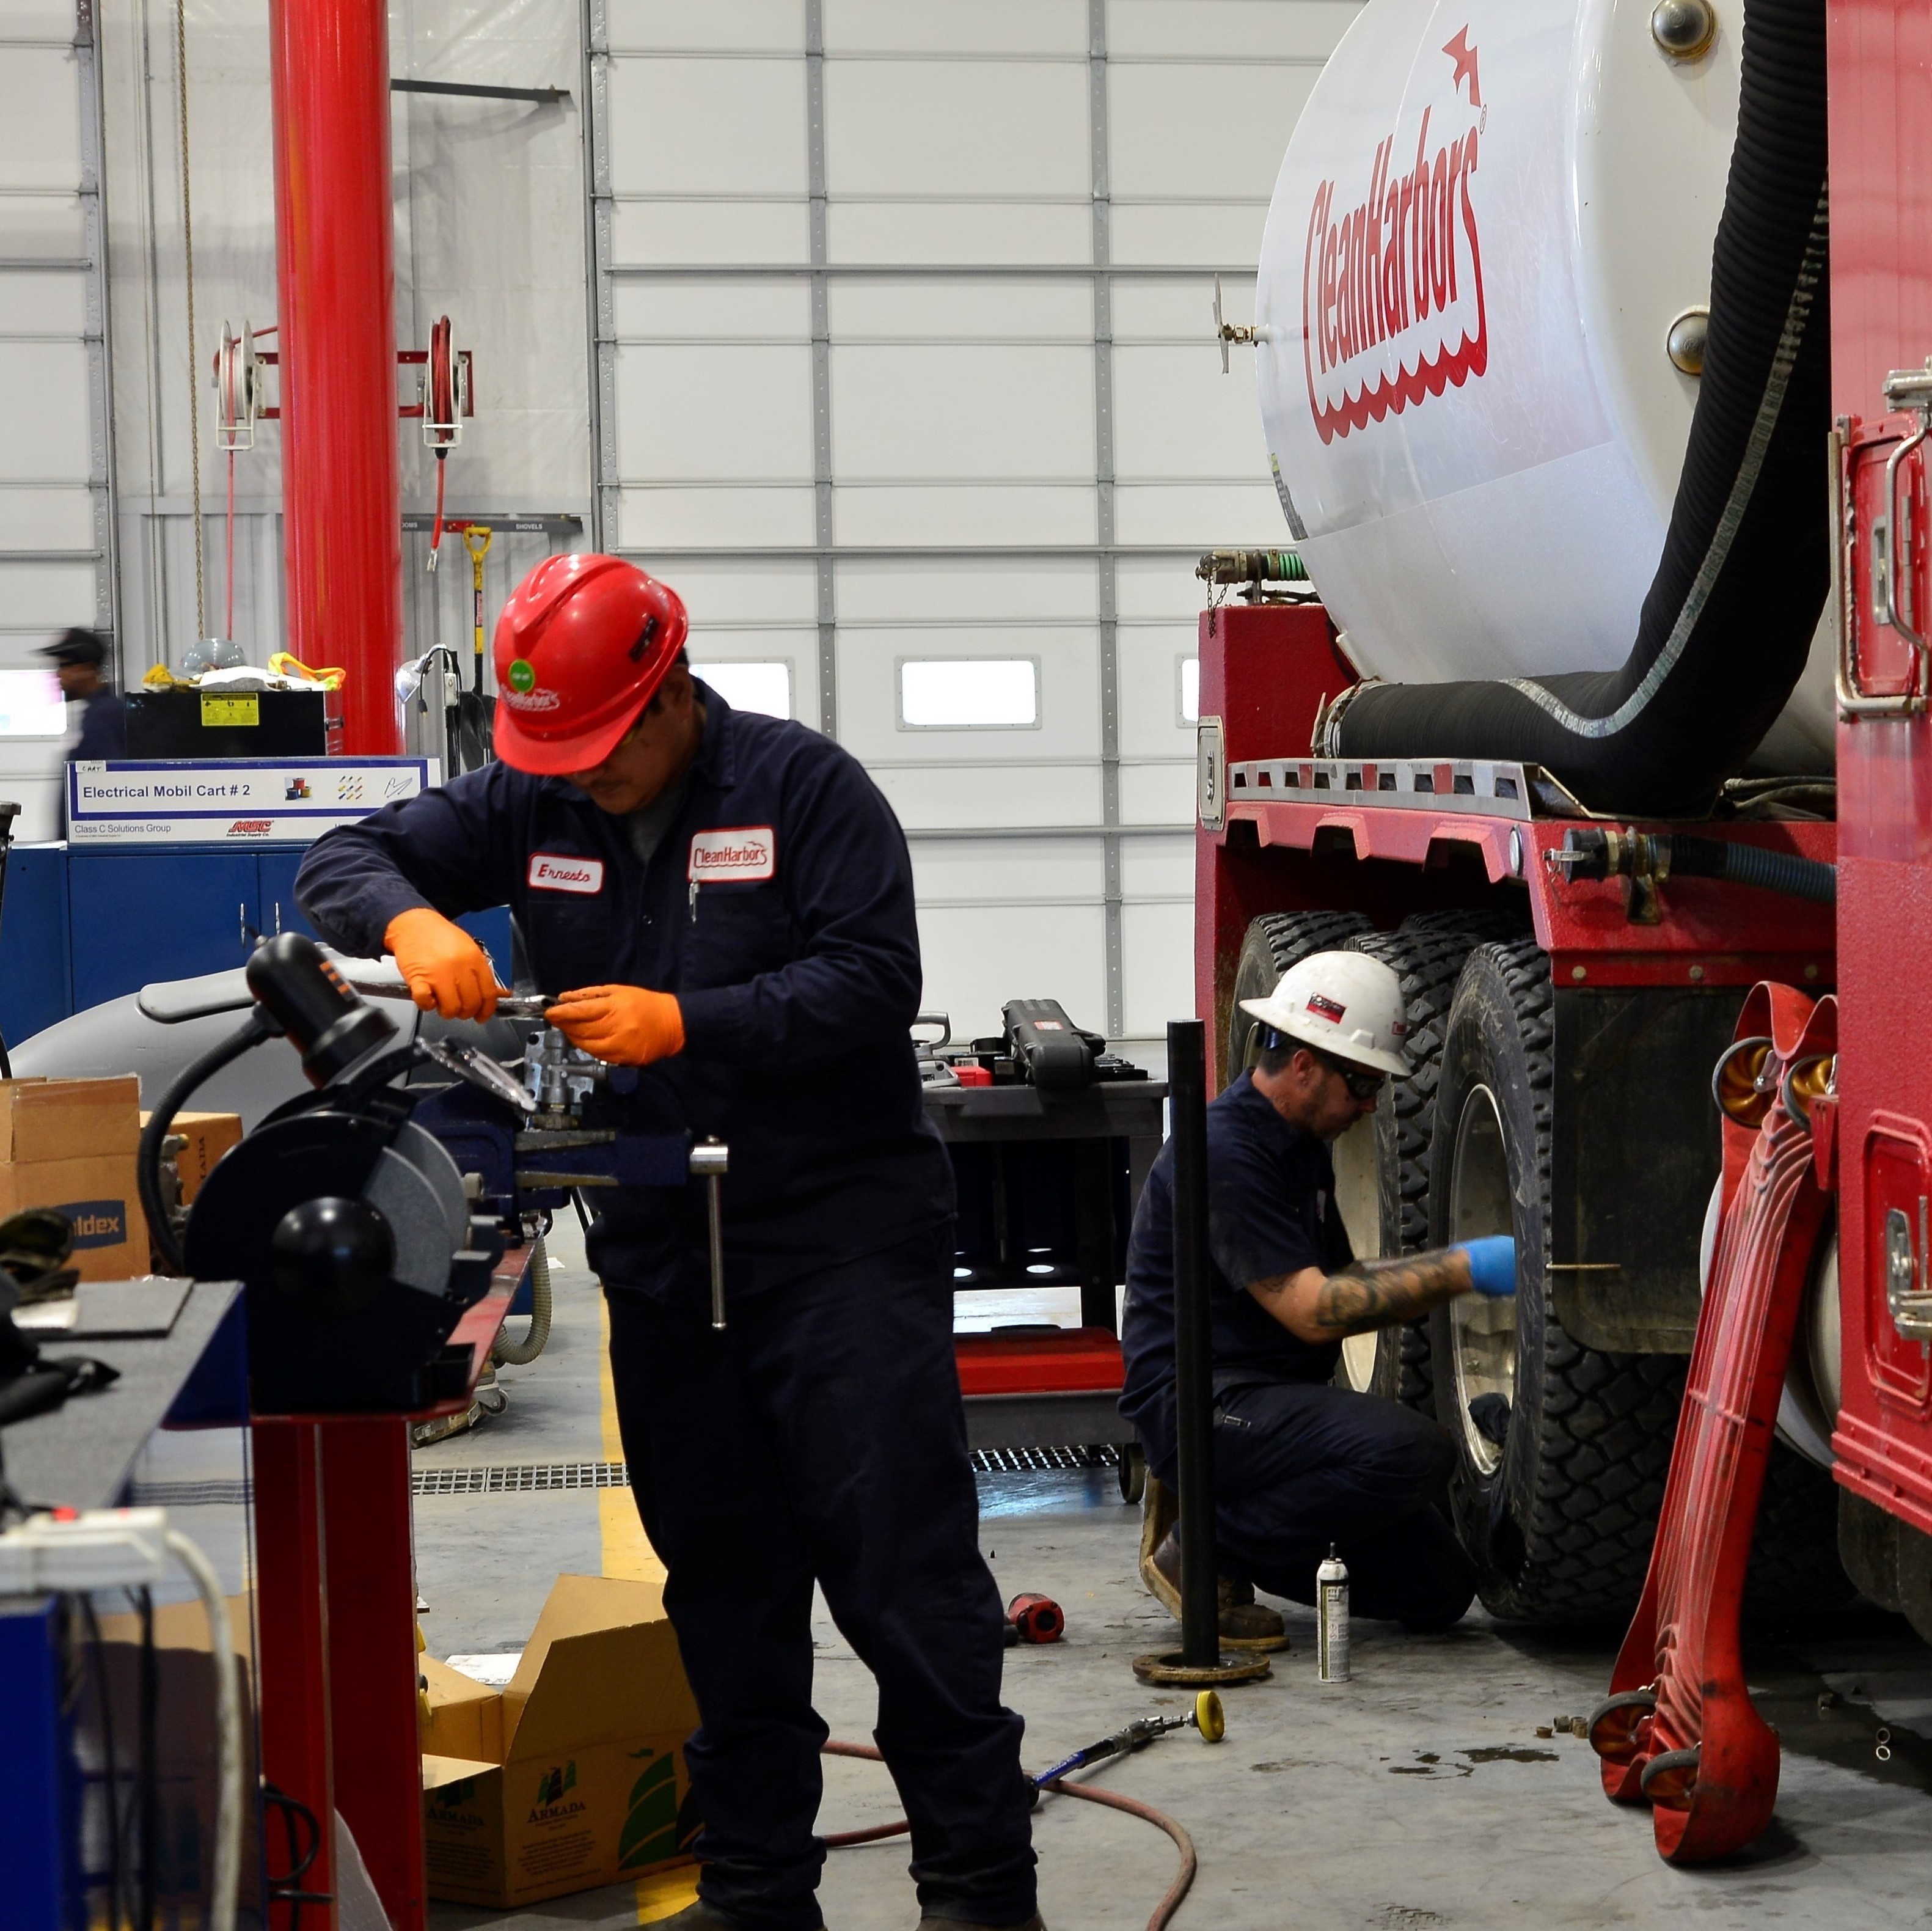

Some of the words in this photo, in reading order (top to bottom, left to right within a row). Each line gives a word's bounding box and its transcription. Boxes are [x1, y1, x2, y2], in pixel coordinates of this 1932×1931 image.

[1303, 105, 1489, 445] CleanHarbors
[1747, 412, 1775, 467] SUCTION
[1764, 371, 1787, 411] HOSE
[83, 786, 148, 798] Electrical
[154, 785, 192, 797] Mobil
[196, 785, 226, 796] Cart
[230, 785, 238, 795] #
[243, 784, 251, 796] 2
[75, 824, 97, 833] Class
[99, 824, 106, 833] C
[108, 824, 144, 833] Solutions
[146, 823, 171, 834] Group
[228, 820, 272, 832] MSC
[694, 846, 767, 868] CleanHarbors
[538, 863, 590, 883] Ernesto
[74, 1214, 119, 1237] ldex
[427, 1804, 485, 1827] ARMADA
[527, 1801, 587, 1824] ARMADA
